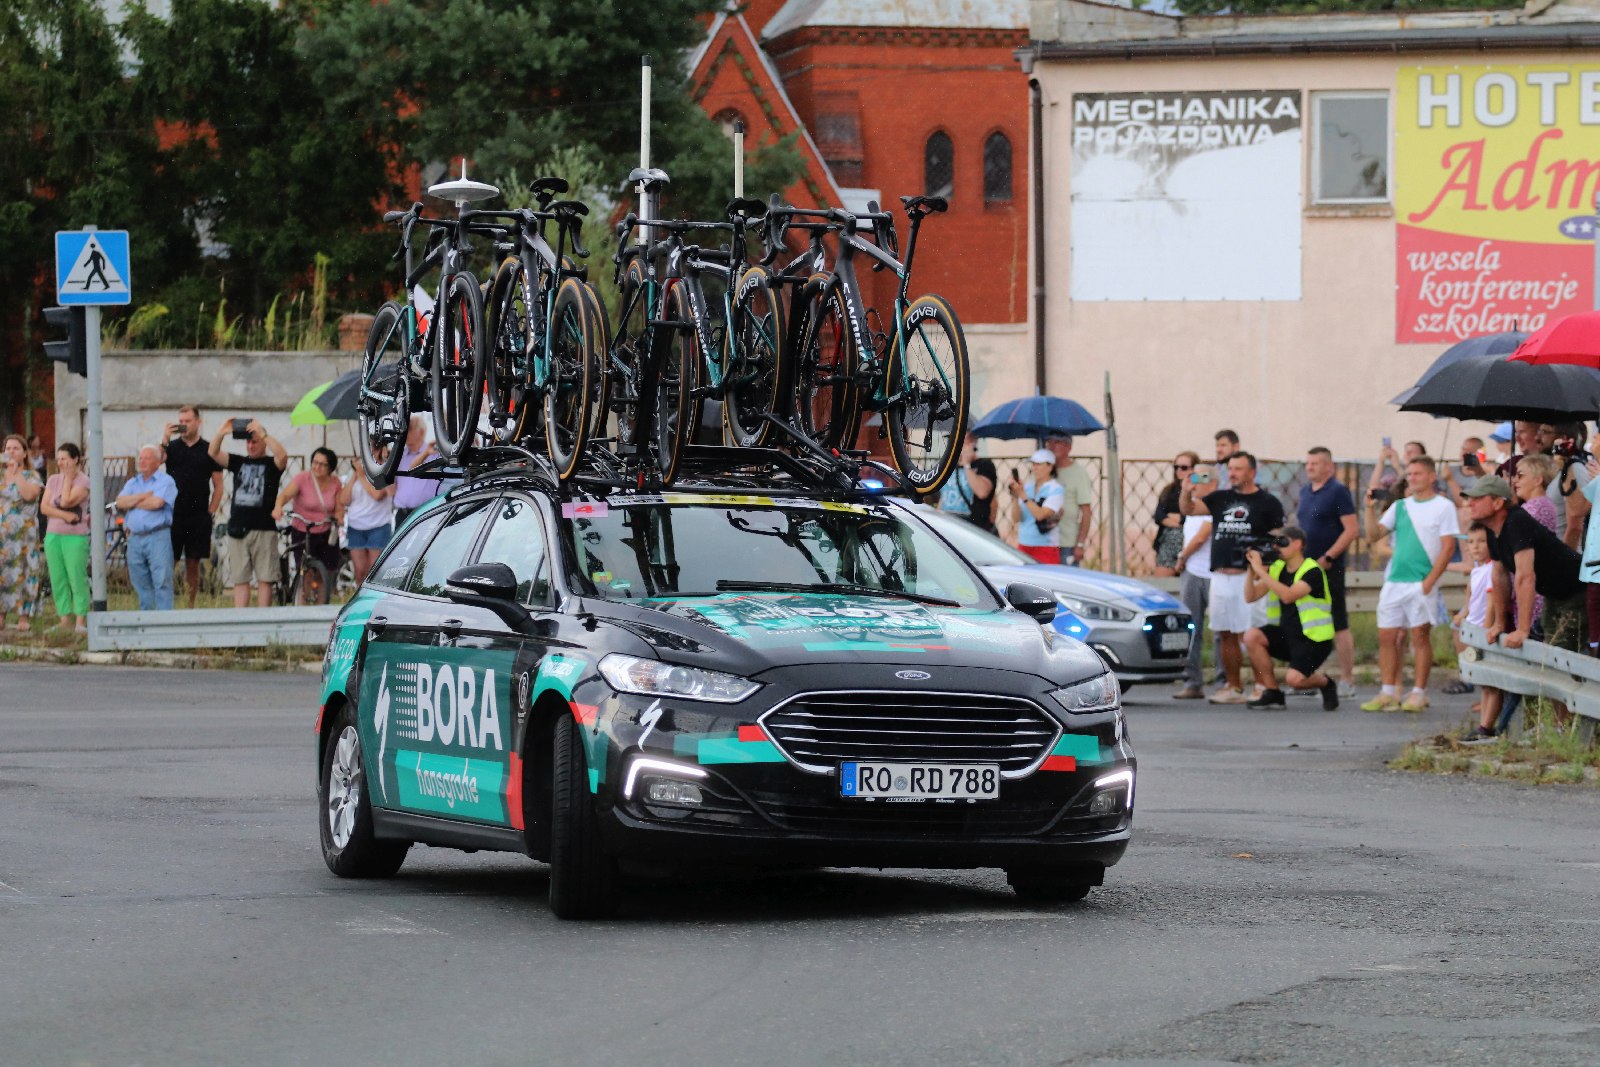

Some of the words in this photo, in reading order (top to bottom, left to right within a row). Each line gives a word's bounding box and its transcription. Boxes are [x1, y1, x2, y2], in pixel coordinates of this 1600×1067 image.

[1074, 97, 1299, 122] MECHANIKA
[1407, 241, 1501, 271] wesela
[1419, 272, 1578, 310] konferencje
[906, 306, 937, 330] roval
[1413, 303, 1547, 339] szkolenia
[907, 463, 940, 483] roval
[417, 663, 503, 751] BORA
[416, 751, 479, 809] hansgrohe
[858, 766, 892, 792] RO
[949, 768, 996, 794] 788
